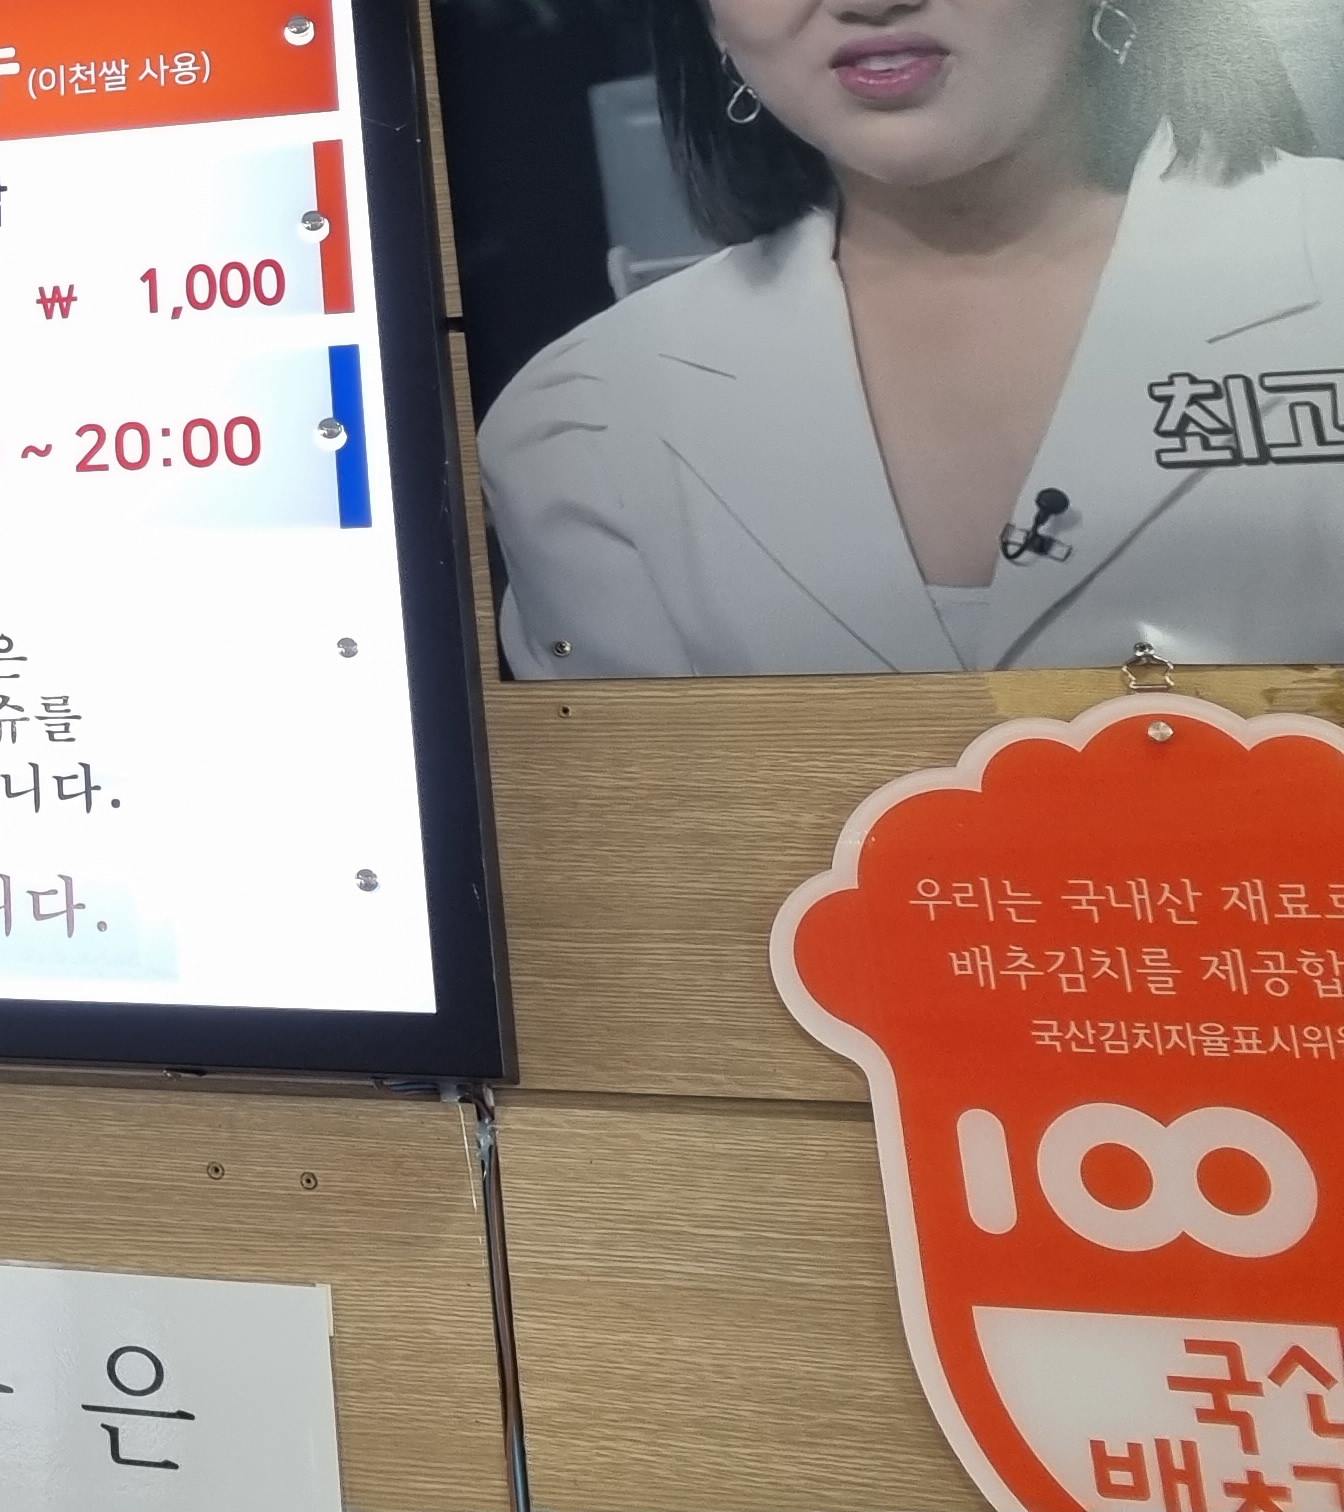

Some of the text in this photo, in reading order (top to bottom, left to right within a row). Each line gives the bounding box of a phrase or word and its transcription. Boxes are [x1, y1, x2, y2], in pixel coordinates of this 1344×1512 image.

[138, 50, 213, 89] 사용)
[139, 259, 287, 322] 1,000
[74, 414, 262, 474] 20:00
[1147, 371, 1344, 469] 최고
[909, 877, 1043, 924] 우리는
[1060, 878, 1202, 926] 국내산
[948, 945, 1344, 999] 배추김치를 제공합
[1030, 1019, 1344, 1060] 국산김치자율표시위
[957, 1102, 1318, 1258] 100
